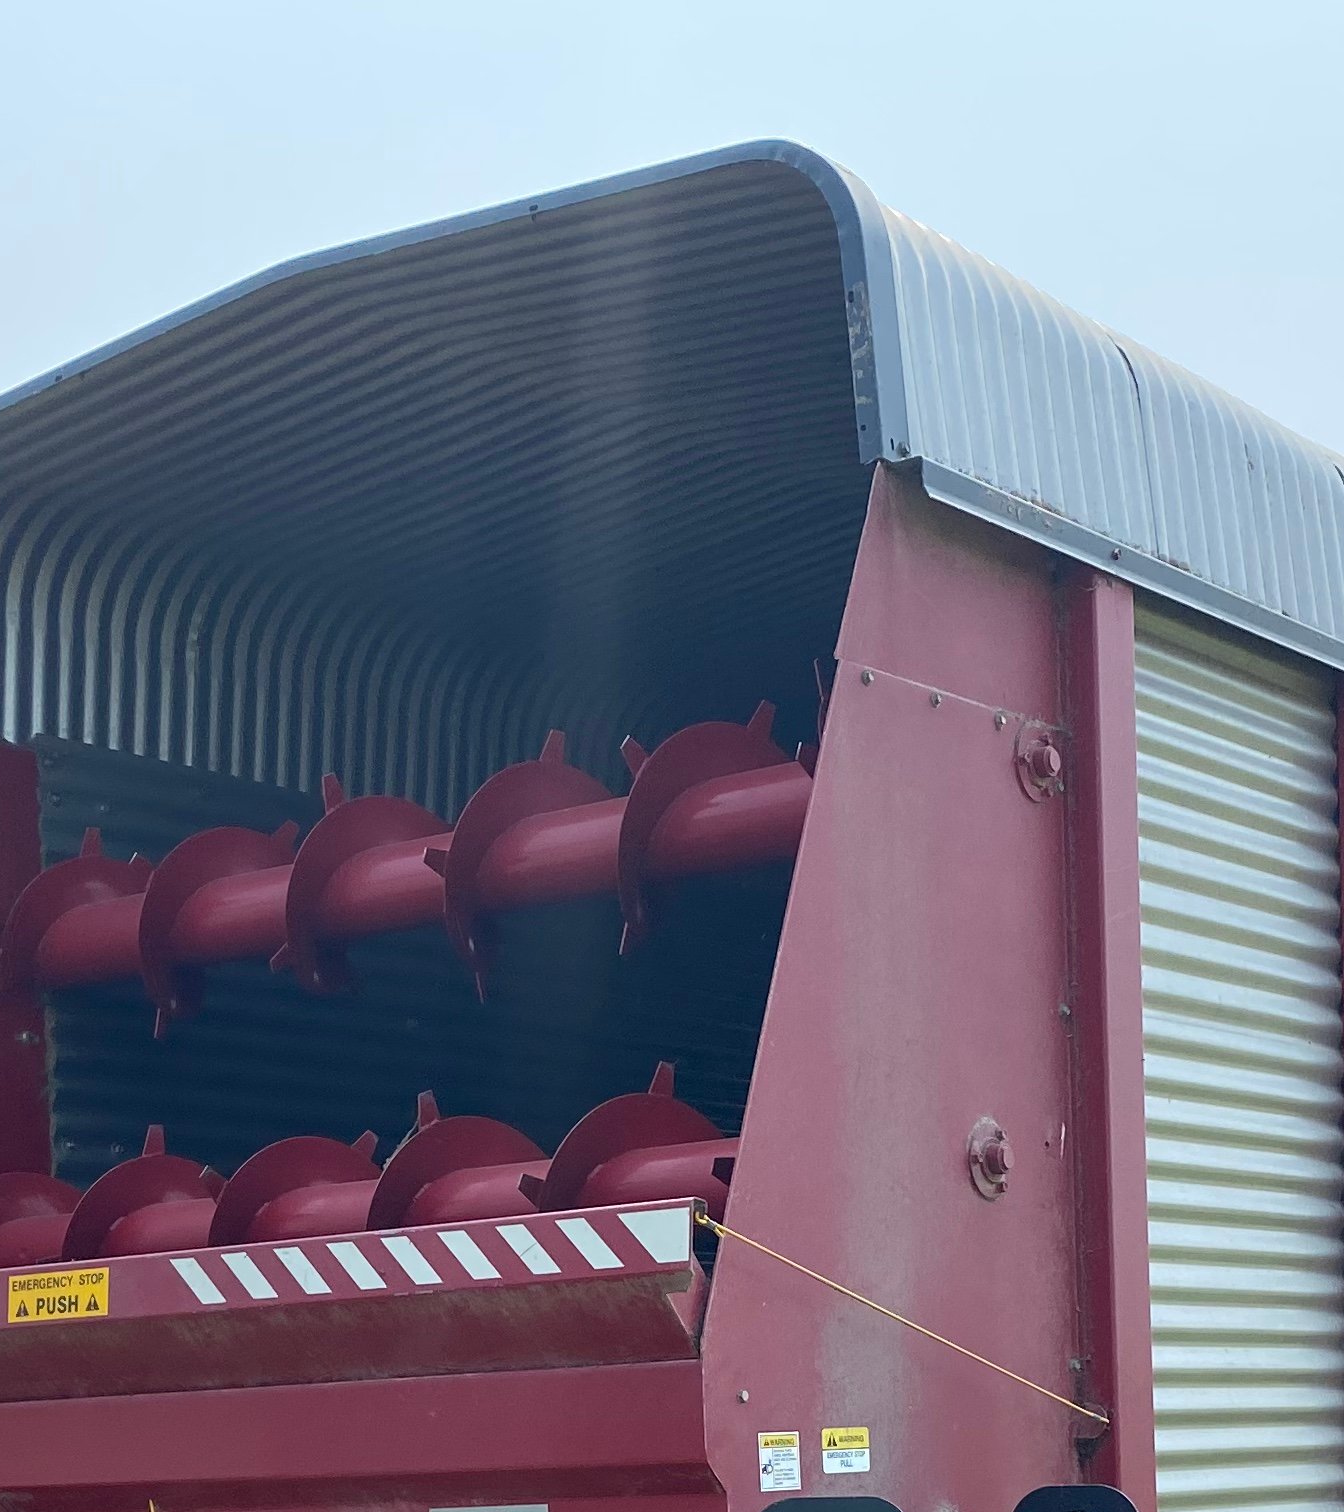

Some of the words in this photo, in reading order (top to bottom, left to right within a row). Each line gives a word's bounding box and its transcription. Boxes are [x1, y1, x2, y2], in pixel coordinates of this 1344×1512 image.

[12, 1275, 74, 1293] EMERGENCY
[79, 1273, 105, 1286] STOP
[36, 1294, 79, 1316] PUSH
[827, 1451, 853, 1460] EMERGENCY
[854, 1450, 866, 1459] STOP
[840, 1459, 853, 1468] PULL
